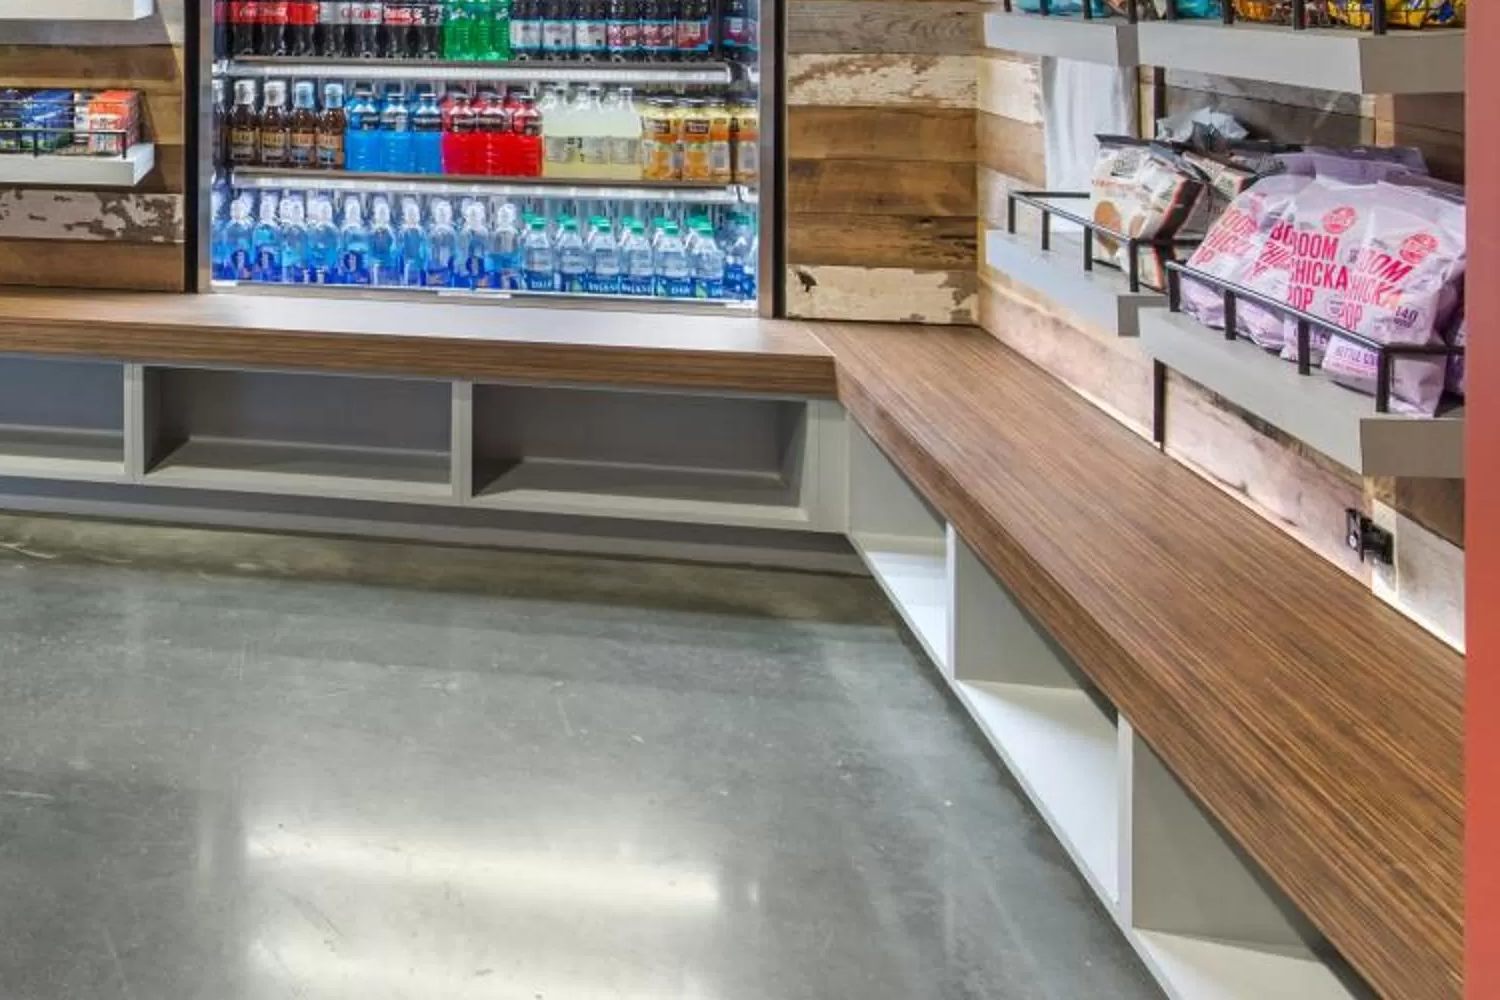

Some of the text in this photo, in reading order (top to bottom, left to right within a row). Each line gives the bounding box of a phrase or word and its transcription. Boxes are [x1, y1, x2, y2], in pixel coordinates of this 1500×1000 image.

[1291, 231, 1339, 261] OOM
[1290, 258, 1349, 291] HICKA
[1288, 286, 1314, 313] OP
